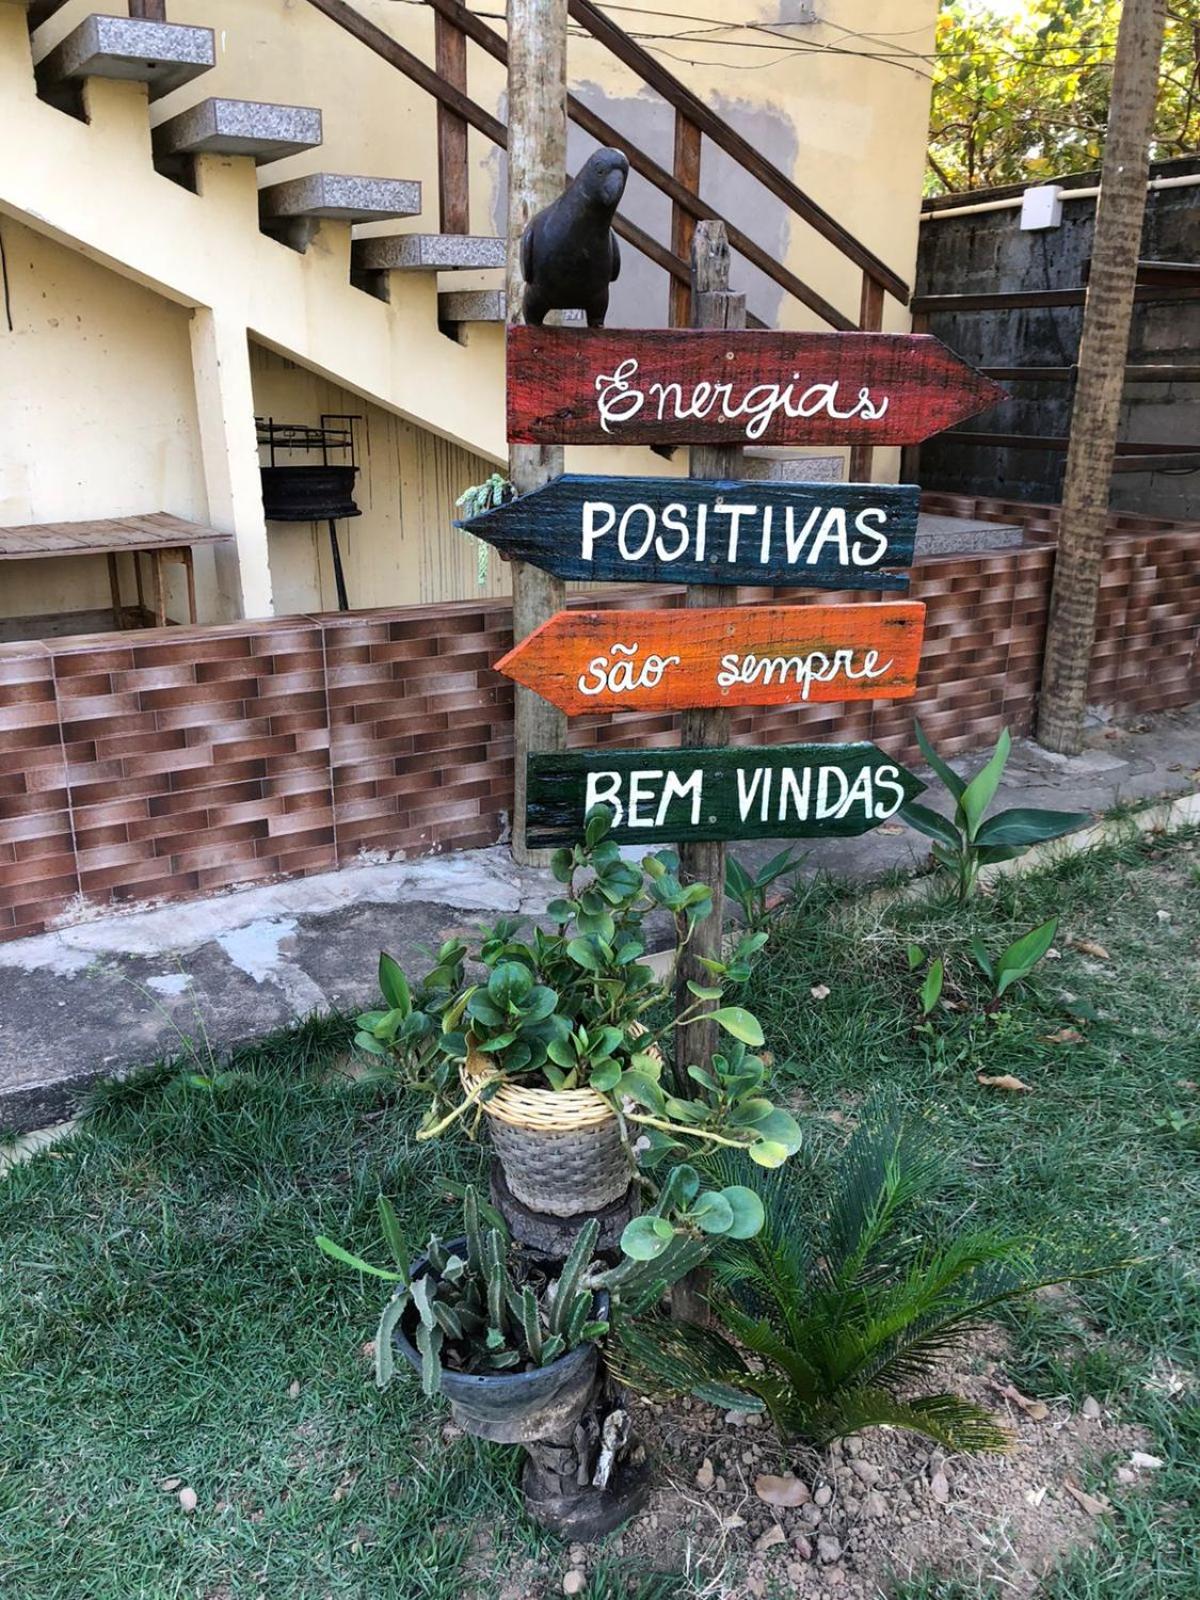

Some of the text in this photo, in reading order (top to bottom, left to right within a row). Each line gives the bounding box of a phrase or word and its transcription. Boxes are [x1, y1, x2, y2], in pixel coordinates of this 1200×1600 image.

[595, 358, 889, 440] Energias
[581, 500, 888, 567] POSITIVAS
[578, 641, 893, 700] são sempre
[585, 764, 904, 828] BEM VINDAS
